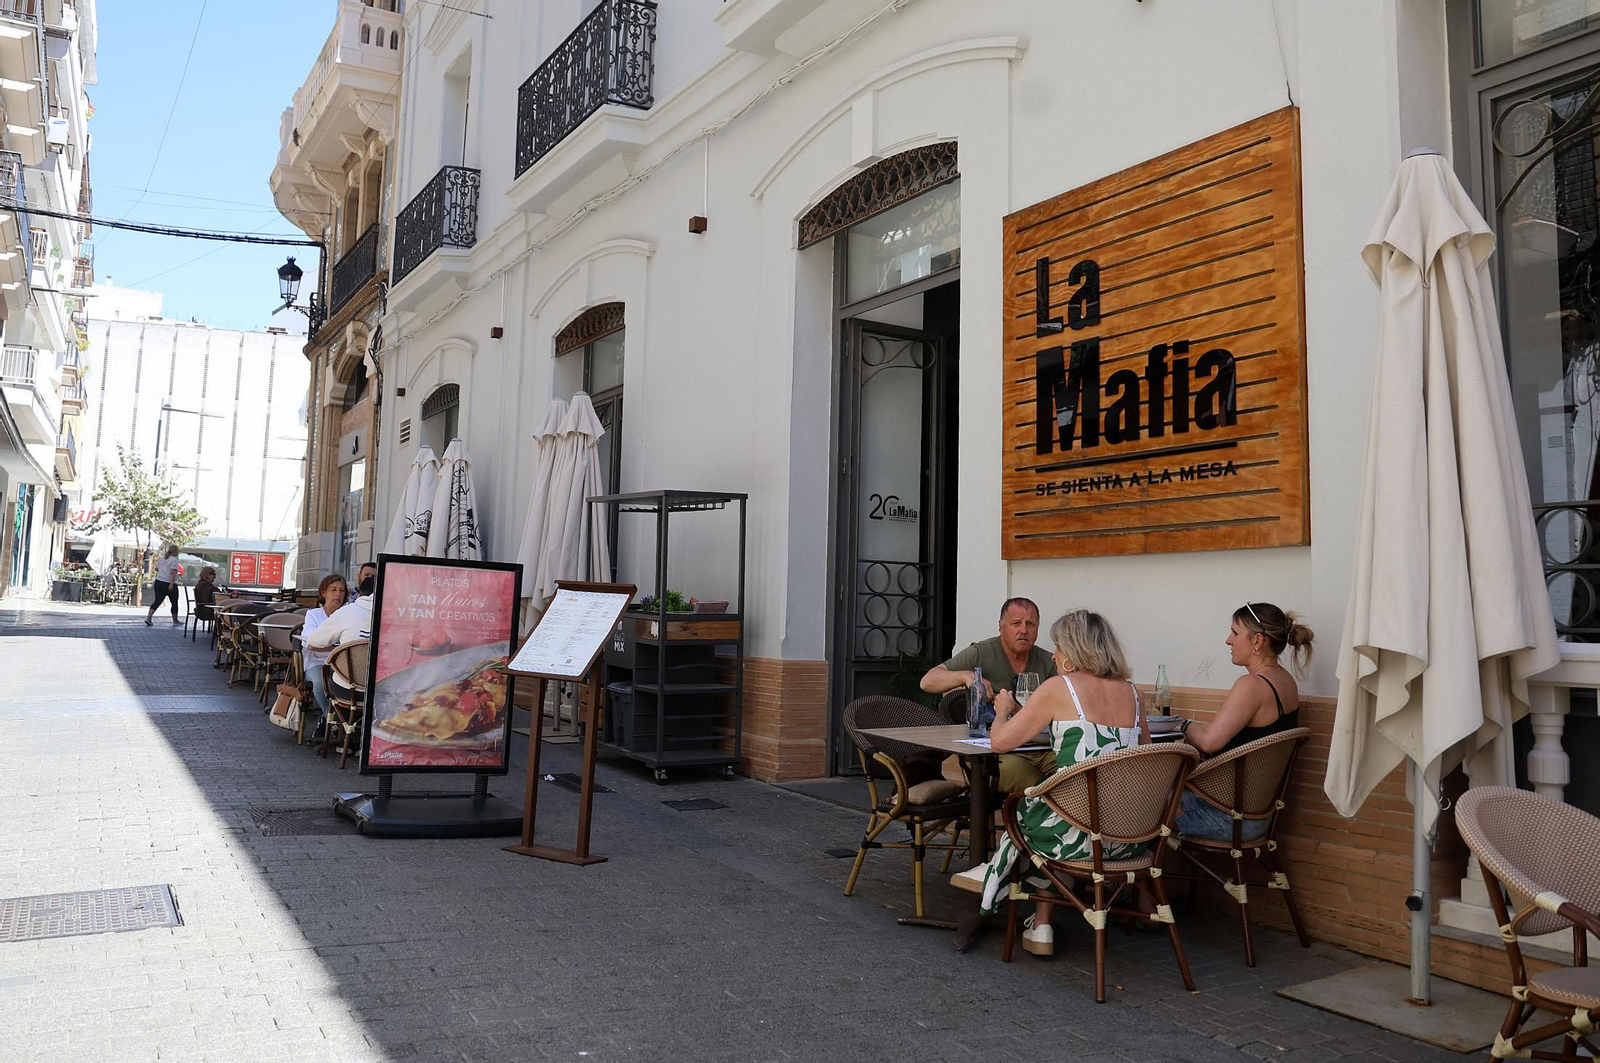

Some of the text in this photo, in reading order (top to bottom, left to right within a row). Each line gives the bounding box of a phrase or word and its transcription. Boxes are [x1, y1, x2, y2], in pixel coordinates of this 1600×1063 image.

[1036, 257, 1100, 338] La
[1036, 337, 1237, 455] Mafia
[1036, 461, 1237, 496] SE SIENTA A LA MESA
[430, 577, 469, 588] PLATOS
[411, 594, 436, 605] TAN
[397, 607, 495, 622] Y TAN CREATIVOS
